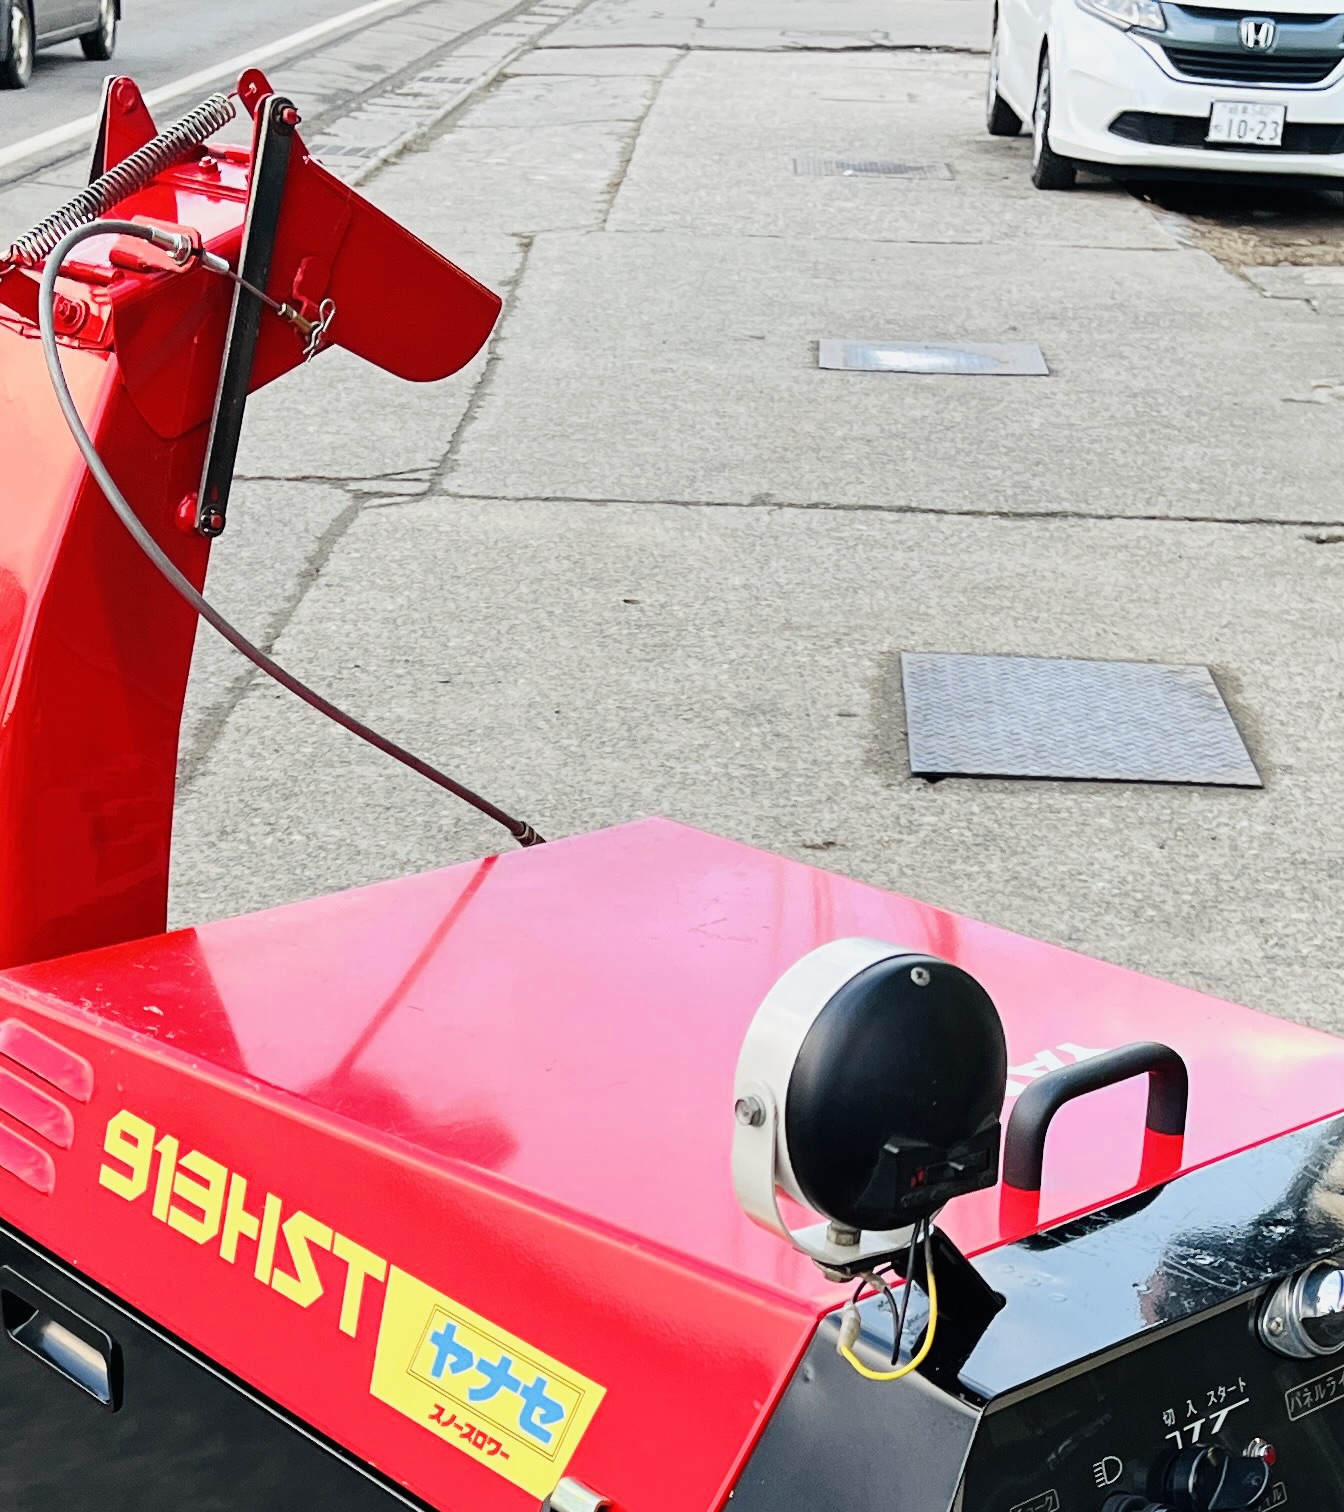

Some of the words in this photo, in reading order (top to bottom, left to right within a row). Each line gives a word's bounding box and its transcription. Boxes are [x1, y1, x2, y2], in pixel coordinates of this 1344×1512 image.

[1227, 119, 1279, 140] 10-23
[99, 1109, 386, 1339] 913HST
[428, 1322, 565, 1444] ヤナセ
[1161, 1408, 1176, 1426] 切
[1184, 1399, 1200, 1418] 入
[1207, 1377, 1248, 1407] スタート
[428, 1402, 512, 1461] スノースロワー
